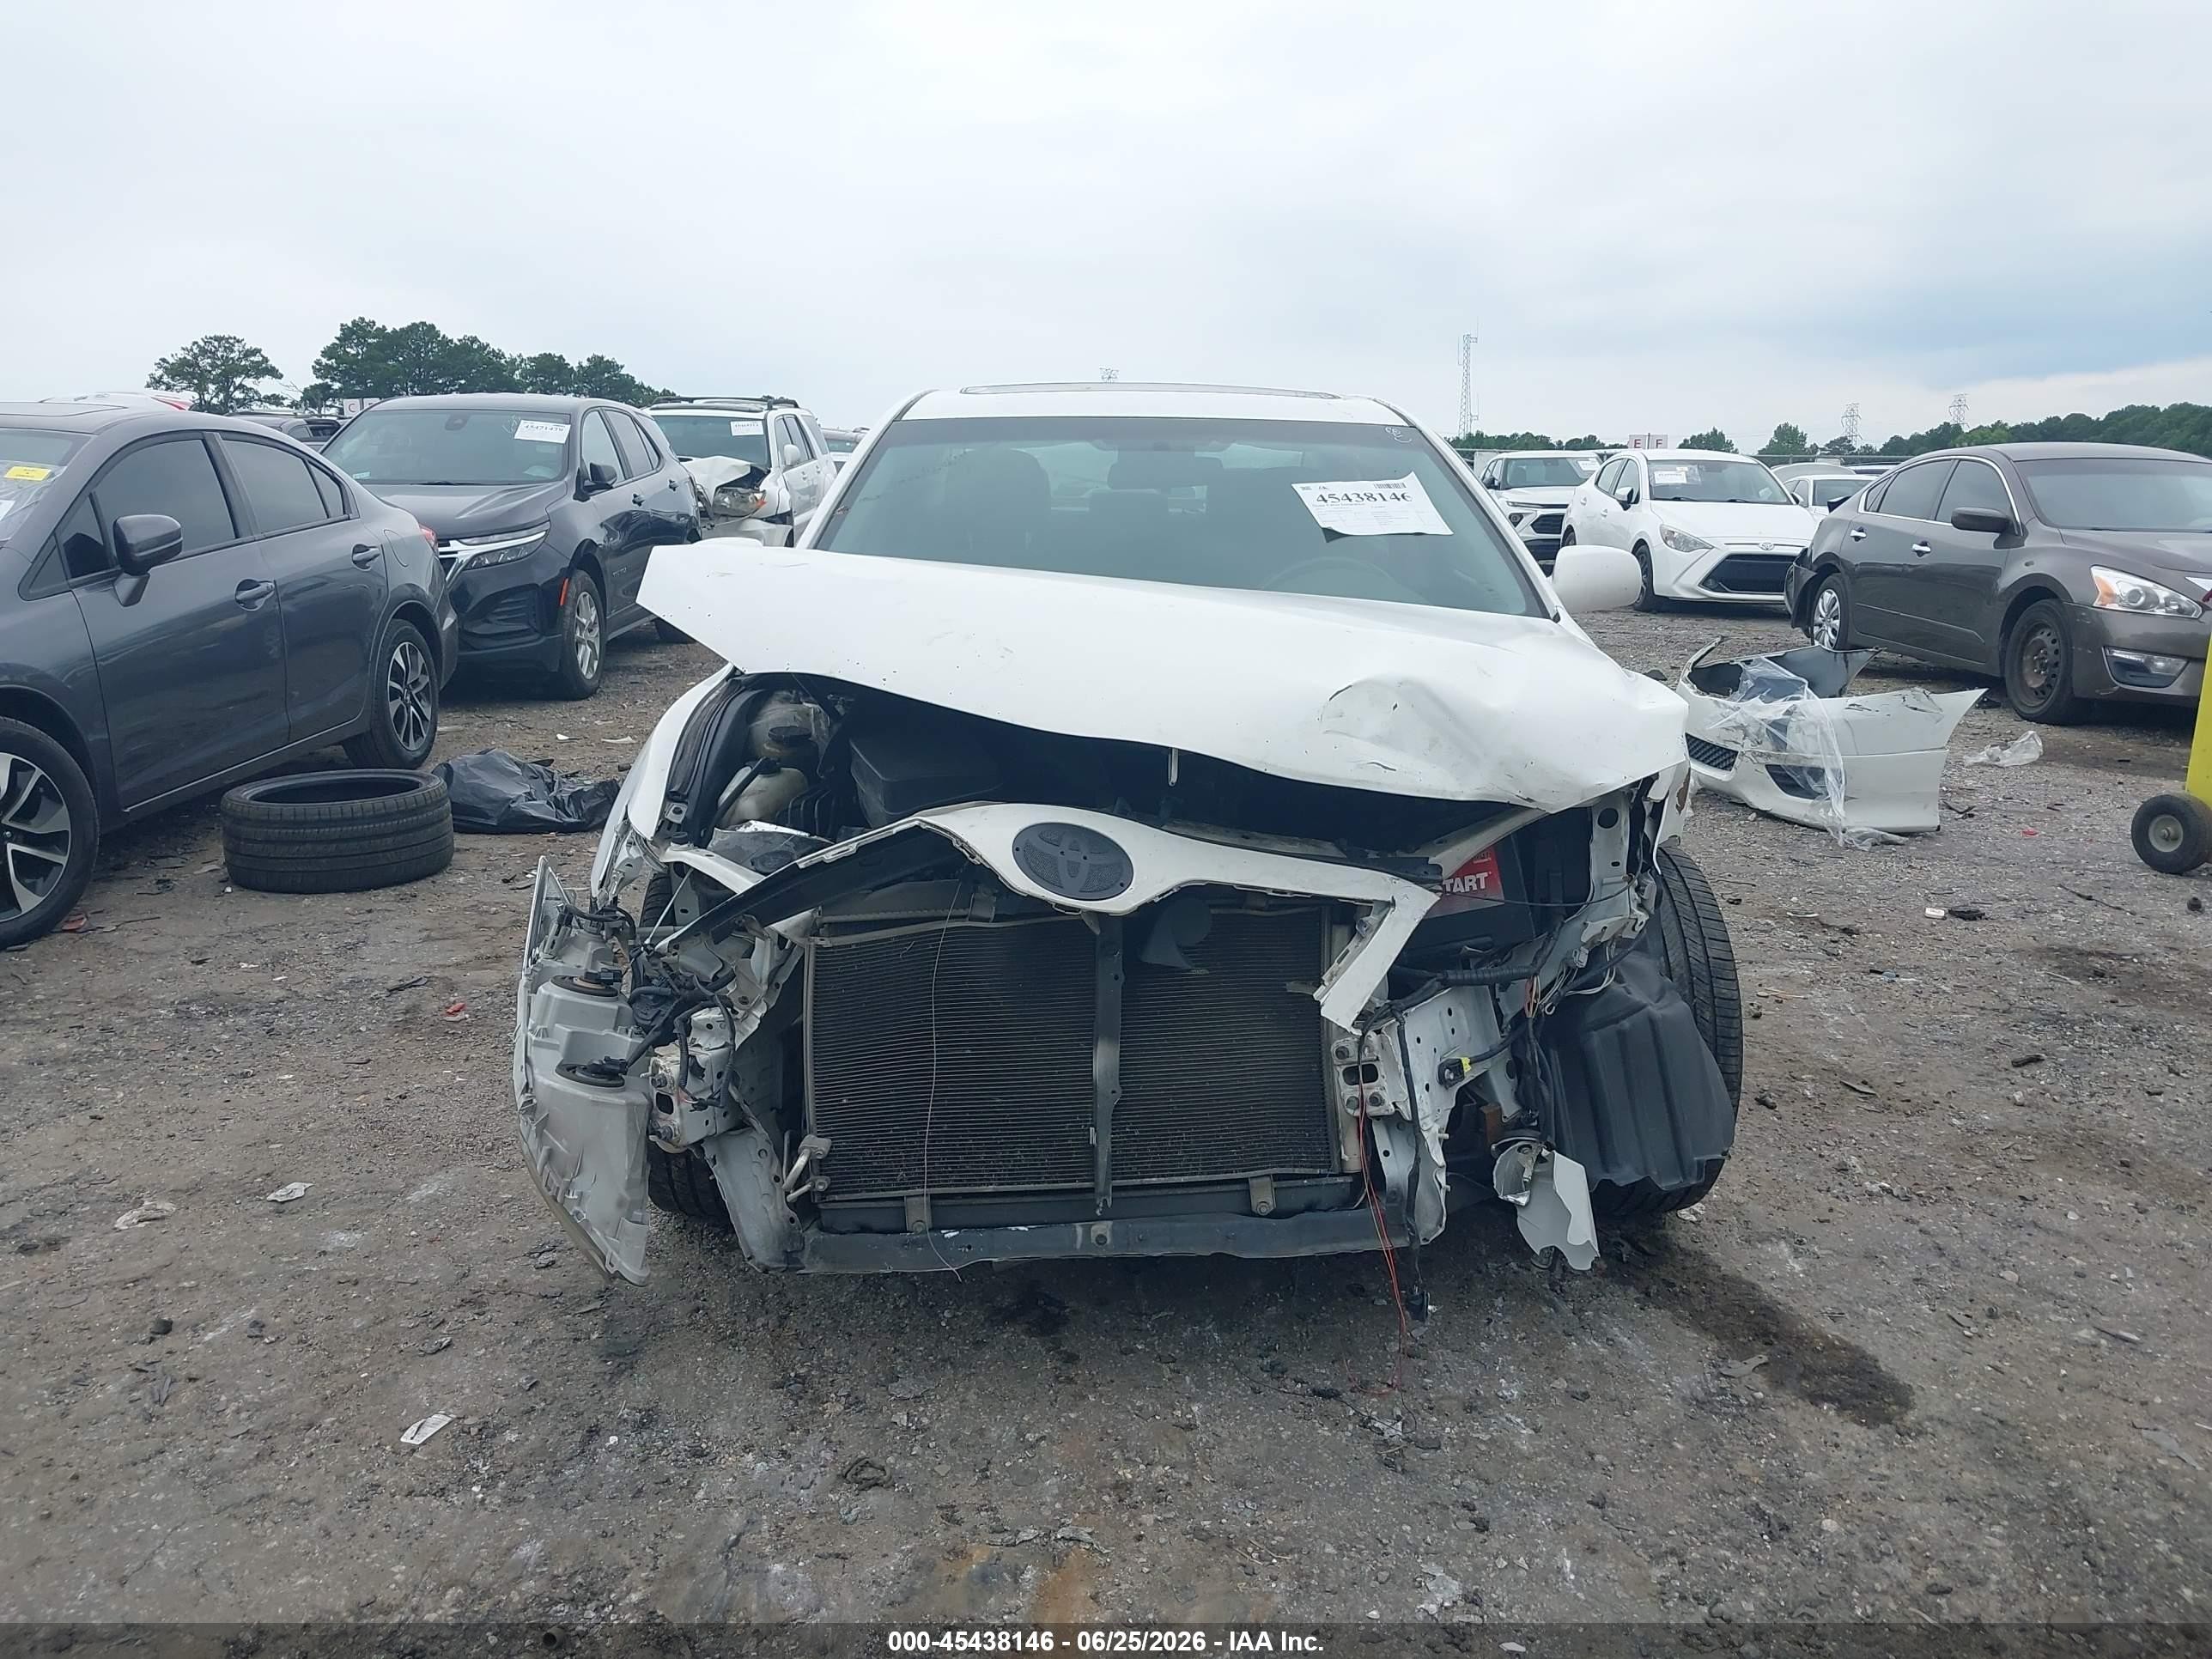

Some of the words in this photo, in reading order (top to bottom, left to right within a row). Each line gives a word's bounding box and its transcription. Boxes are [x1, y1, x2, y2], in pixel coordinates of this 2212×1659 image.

[348, 402, 356, 413] C
[1633, 439, 1642, 448] E
[1656, 439, 1663, 448] F
[1316, 491, 1413, 504] 45438146
